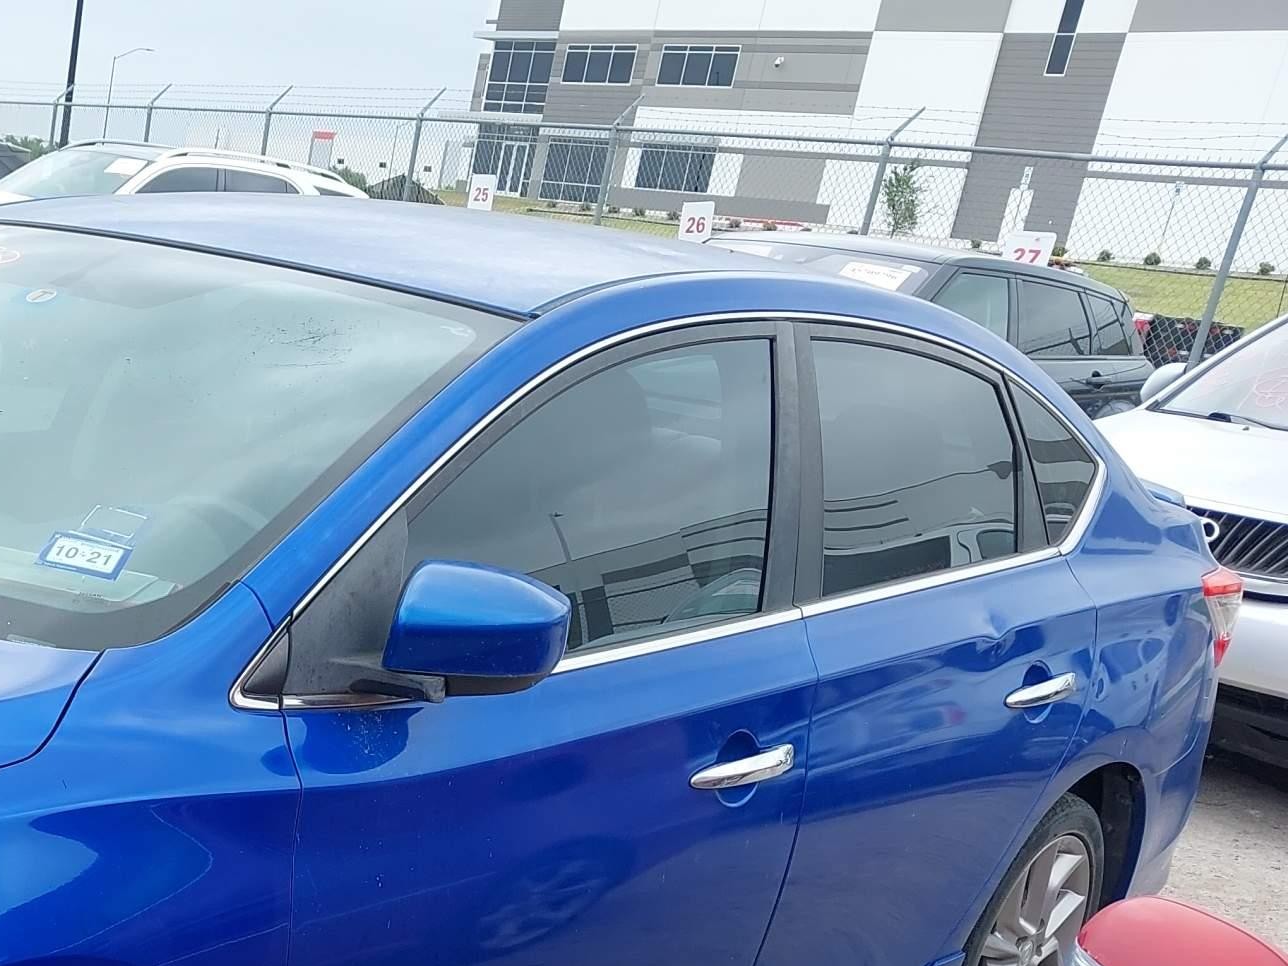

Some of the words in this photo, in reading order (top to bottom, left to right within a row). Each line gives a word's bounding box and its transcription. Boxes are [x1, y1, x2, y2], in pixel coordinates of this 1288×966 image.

[473, 187, 489, 202] 25
[685, 216, 706, 234] 26
[1014, 247, 1042, 264] 27
